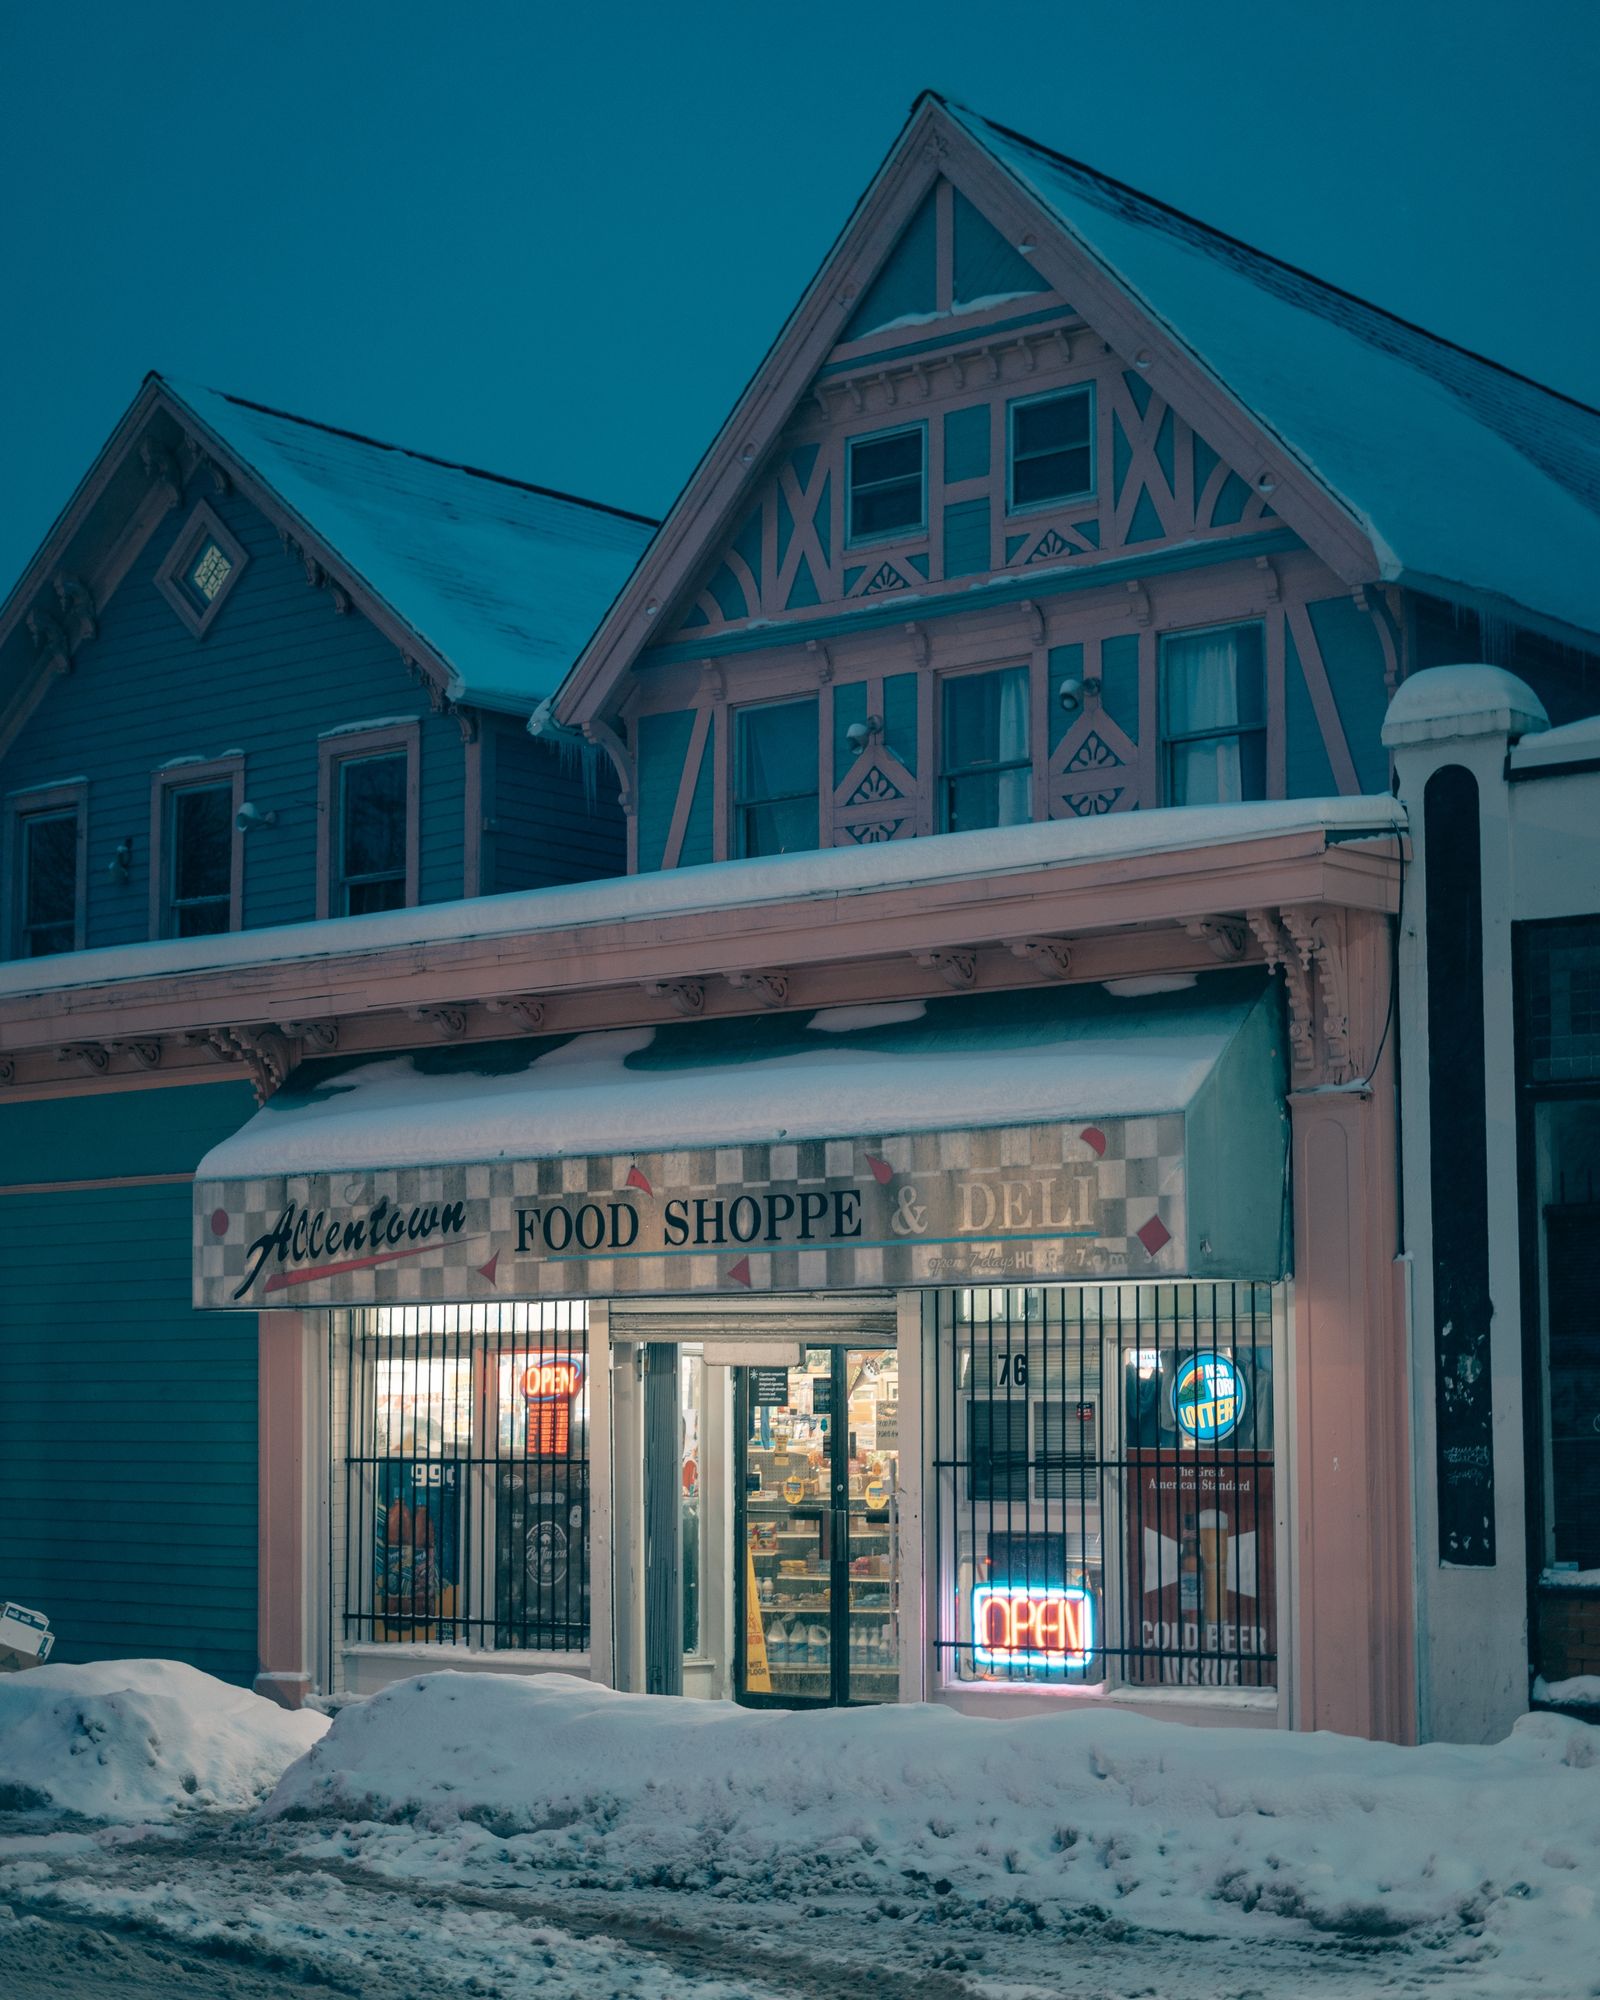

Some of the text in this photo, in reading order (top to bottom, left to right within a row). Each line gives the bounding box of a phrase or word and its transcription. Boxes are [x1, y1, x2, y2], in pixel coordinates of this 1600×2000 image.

[234, 1175, 1095, 1300] Allentown FOOD SHOPPE & DELI
[981, 1248, 1014, 1274] days
[526, 1366, 575, 1395] OPEN
[998, 1354, 1027, 1386] 76
[1180, 1396, 1239, 1428] LOTTER
[1149, 1478, 1199, 1489] Amerca
[1173, 1466, 1225, 1477] he ret
[981, 1597, 1084, 1657] OPEN
[1142, 1621, 1267, 1654] COLD BEER
